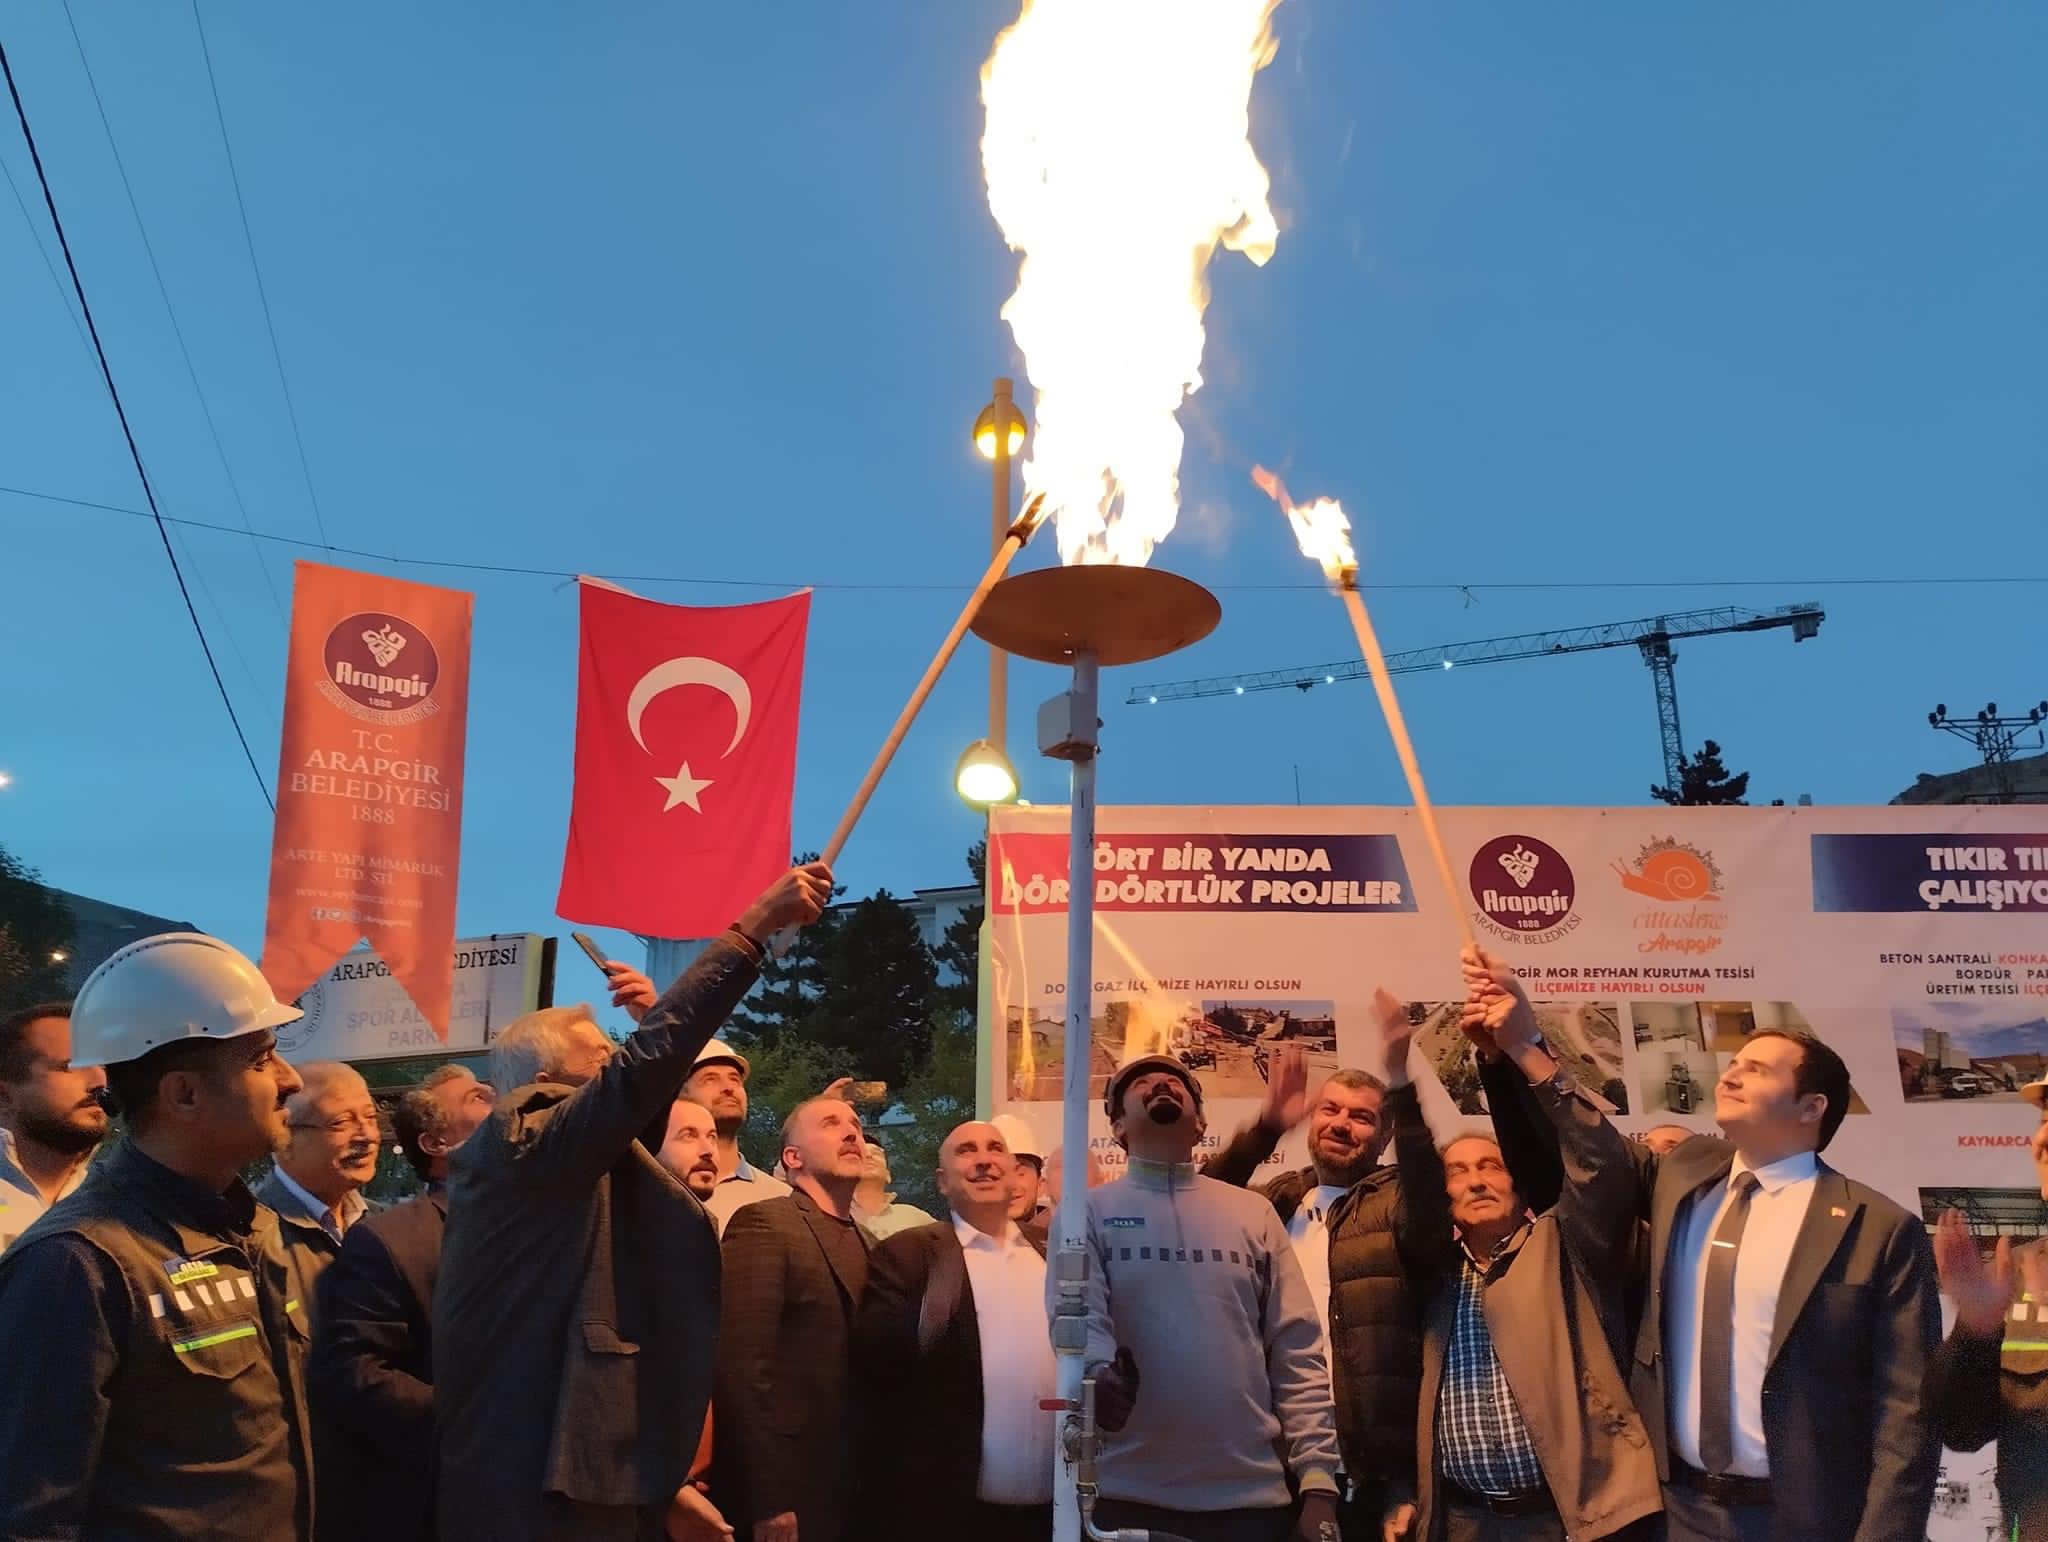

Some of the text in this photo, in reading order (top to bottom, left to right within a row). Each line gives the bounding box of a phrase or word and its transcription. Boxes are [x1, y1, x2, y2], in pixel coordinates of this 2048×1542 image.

[336, 661, 429, 698] Arapgir
[304, 749, 441, 785] ARAPGİR
[290, 772, 451, 811] BELEDİYESİ
[351, 804, 395, 825] 1888
[1162, 842, 1213, 871] BİR
[1220, 847, 1332, 872] YANDA
[1926, 847, 2048, 871] TIKIR TI
[1001, 873, 1402, 906] DÖR DÖRTLÜK PROJELER
[1483, 889, 1568, 915] Arapgir
[1880, 953, 1923, 965] BETON
[1928, 951, 1992, 965] SANTRALİ
[330, 960, 392, 982] ARAPG
[1546, 967, 1579, 978] MOR
[1583, 967, 1641, 978] REYHAN
[1643, 967, 1711, 979] KURUTMA
[1716, 966, 1755, 979] TESİSİ
[1956, 966, 2012, 980] BORDÜR
[1127, 977, 1191, 994] İLÇMİZE
[1195, 979, 1250, 992] HAYIRLI
[1254, 979, 1302, 992] OLSUN
[1535, 981, 1706, 996] İLÇEMİZE HAYIRLI OLSUN
[1926, 981, 1976, 995] ÜRETİM
[1980, 982, 2019, 995] TESİSİ
[1958, 1135, 2033, 1147] KAYNARCA
